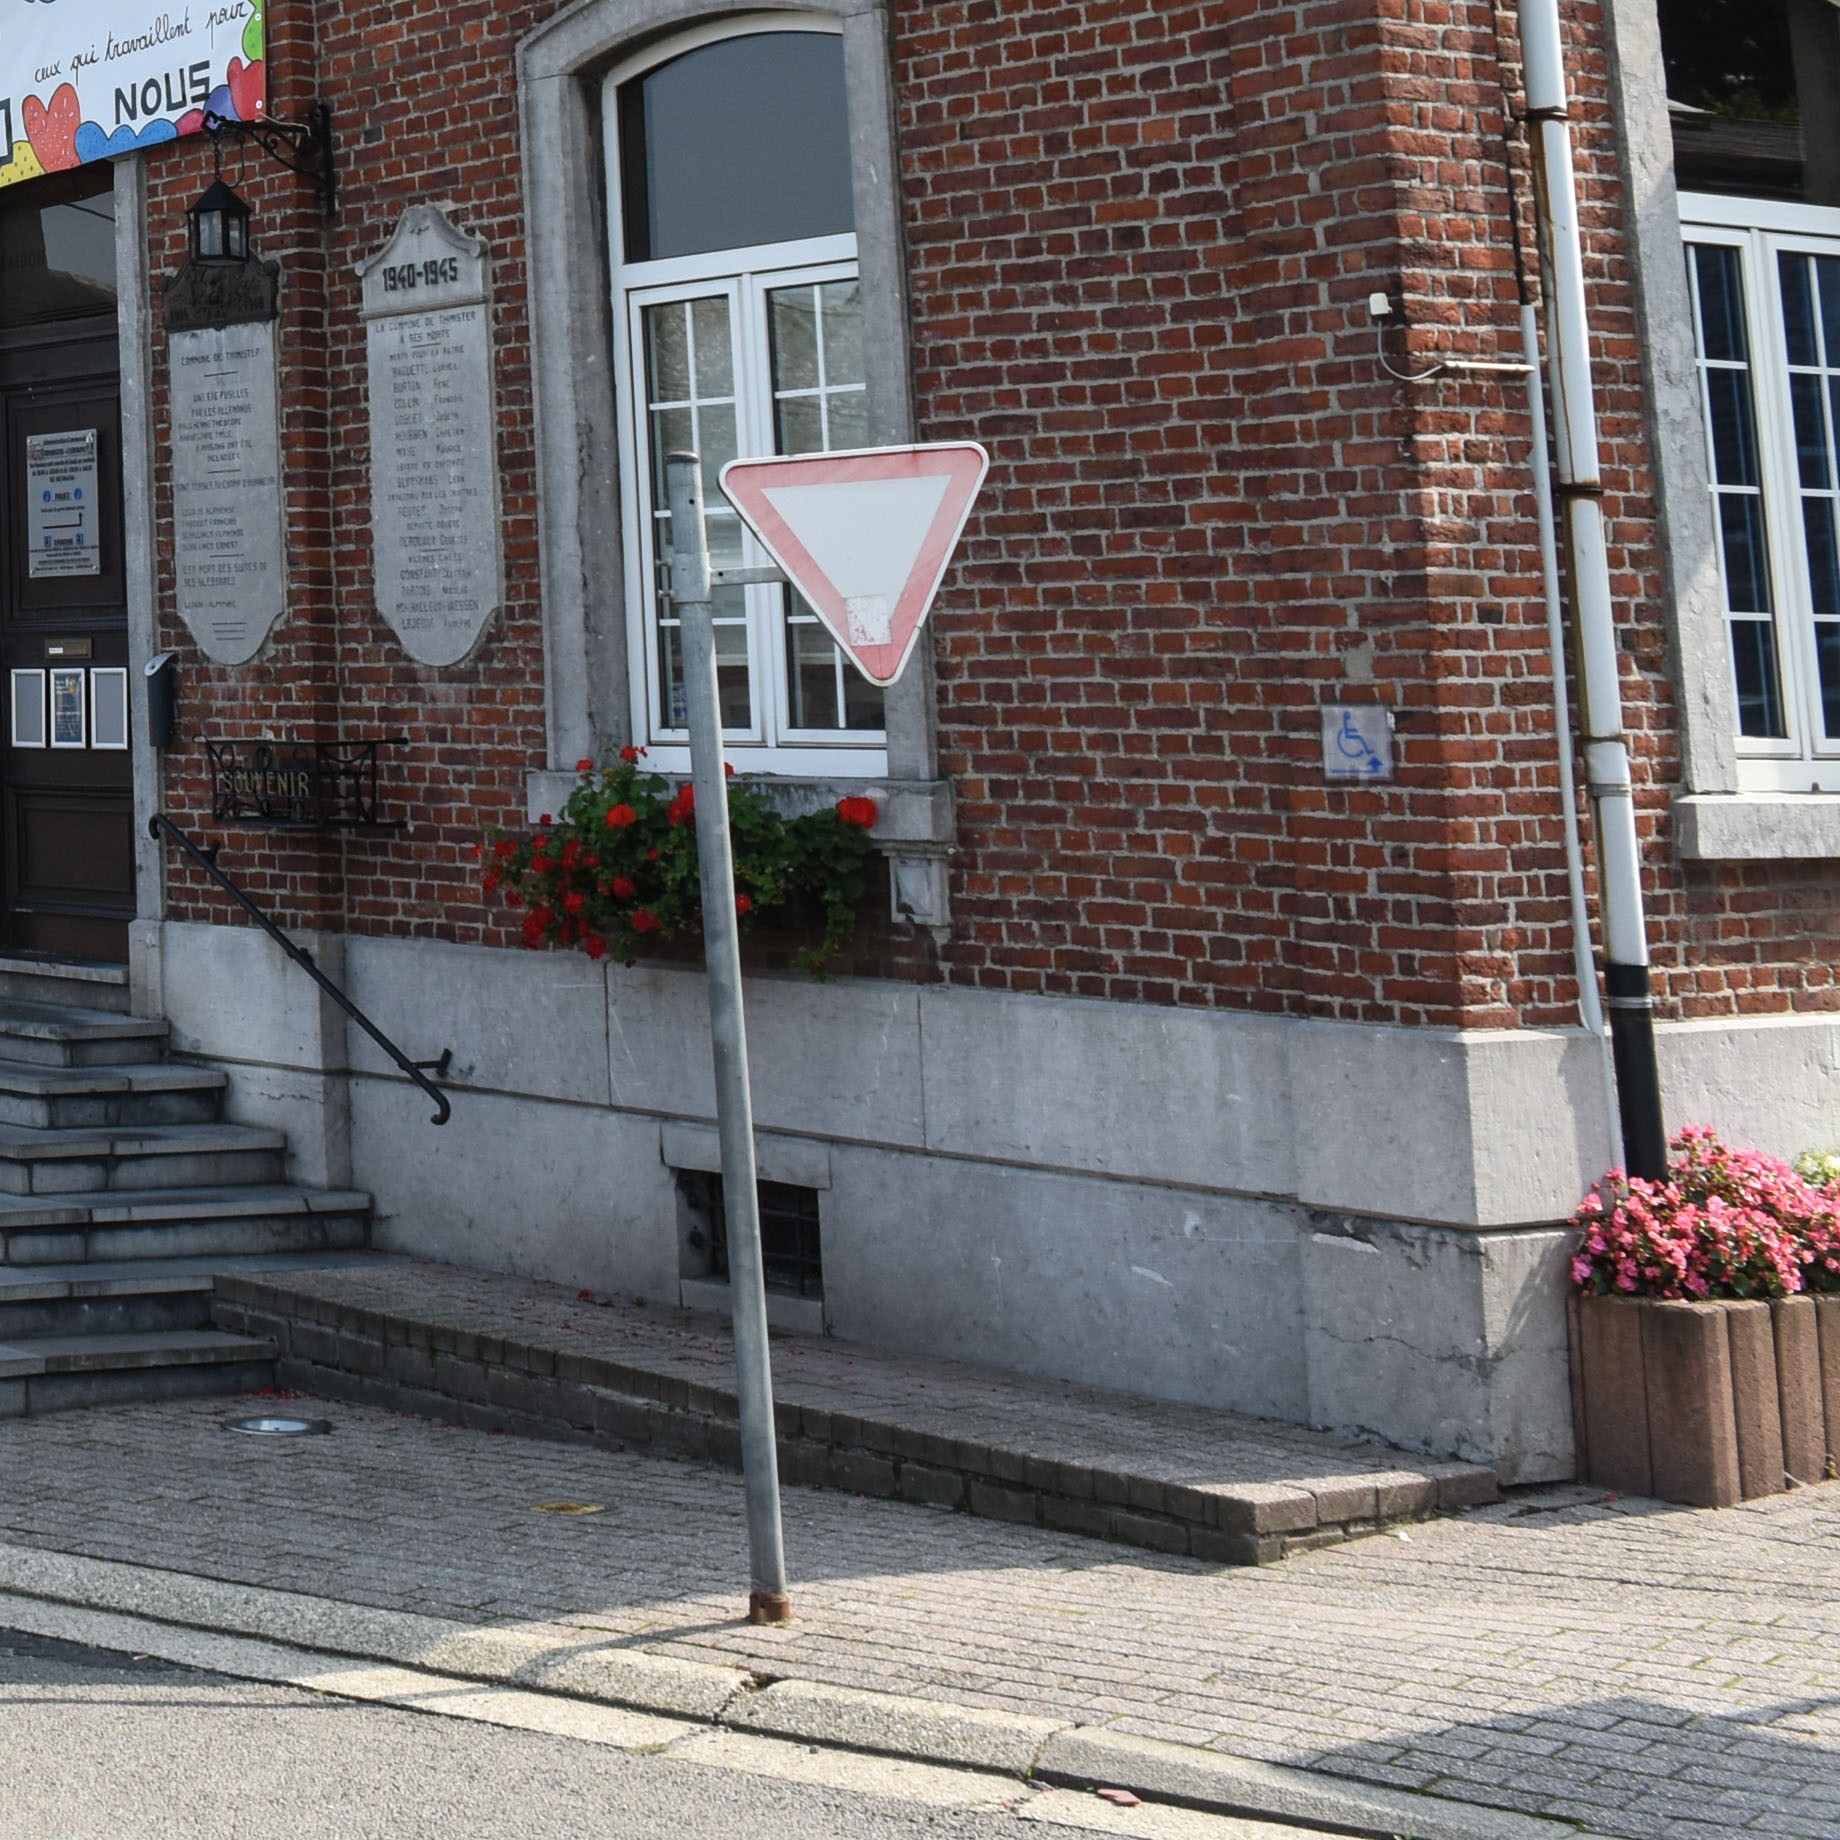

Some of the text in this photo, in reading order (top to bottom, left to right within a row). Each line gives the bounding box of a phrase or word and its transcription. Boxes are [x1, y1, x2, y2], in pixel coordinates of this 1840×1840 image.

[35, 60, 62, 85] ceux
[70, 43, 100, 87] qui
[104, 11, 193, 62] travaillent
[114, 61, 212, 125] NOUS
[382, 256, 459, 292] 1940-1945
[223, 771, 309, 798] SOUVENIR
